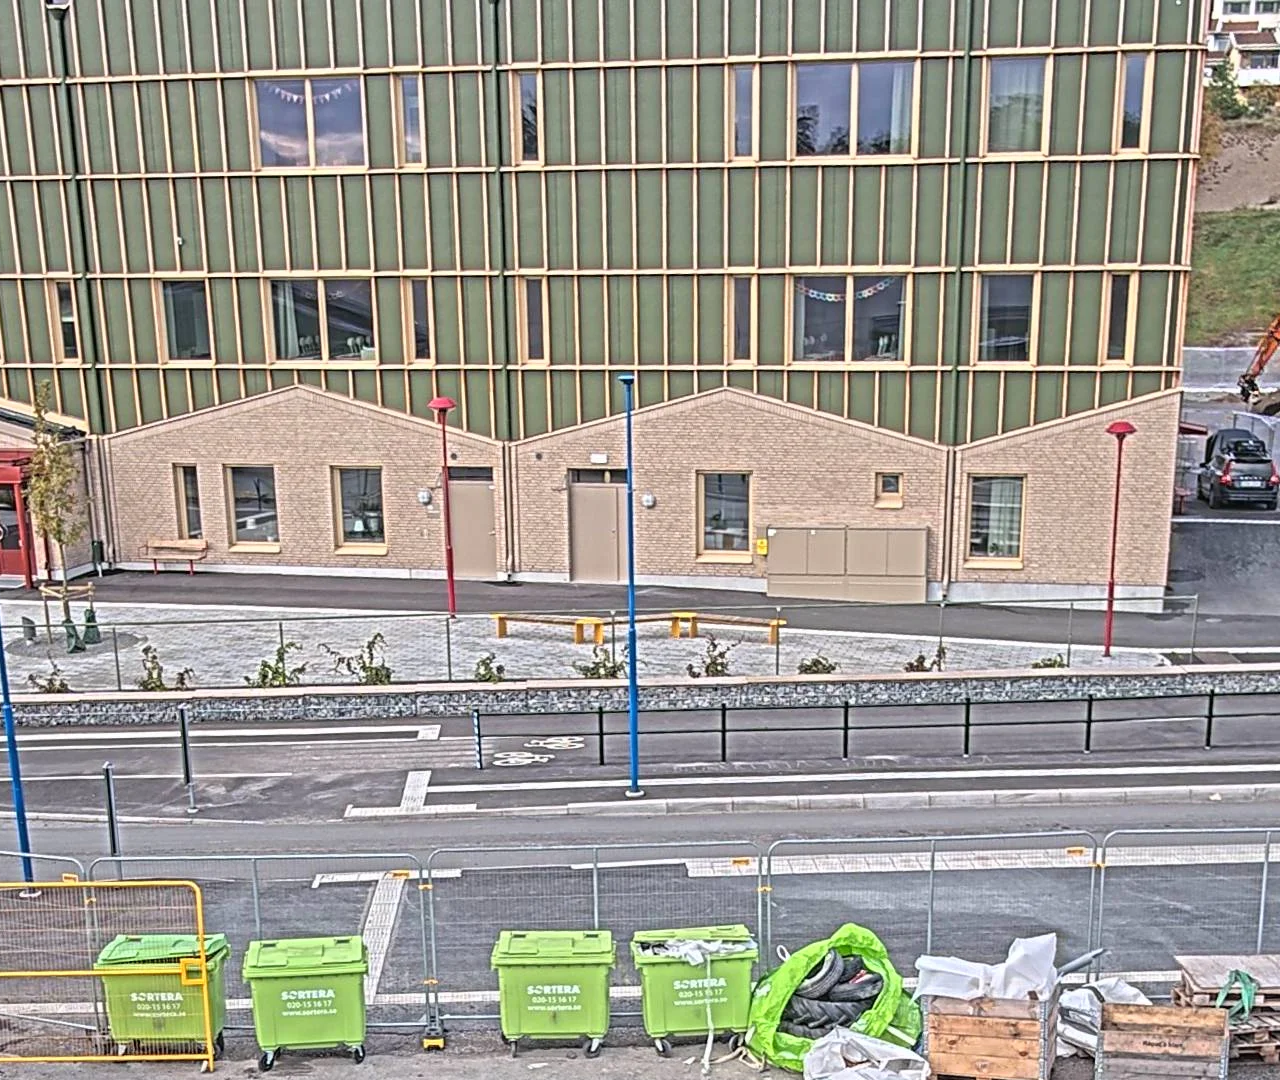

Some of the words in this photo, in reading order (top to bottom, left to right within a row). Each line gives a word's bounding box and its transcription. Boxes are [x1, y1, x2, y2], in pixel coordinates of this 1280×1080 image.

[673, 978, 727, 990] SORTERA
[281, 989, 335, 1000] SORTERA
[527, 985, 580, 995] SORTERA
[130, 992, 183, 1001] SORTERA
